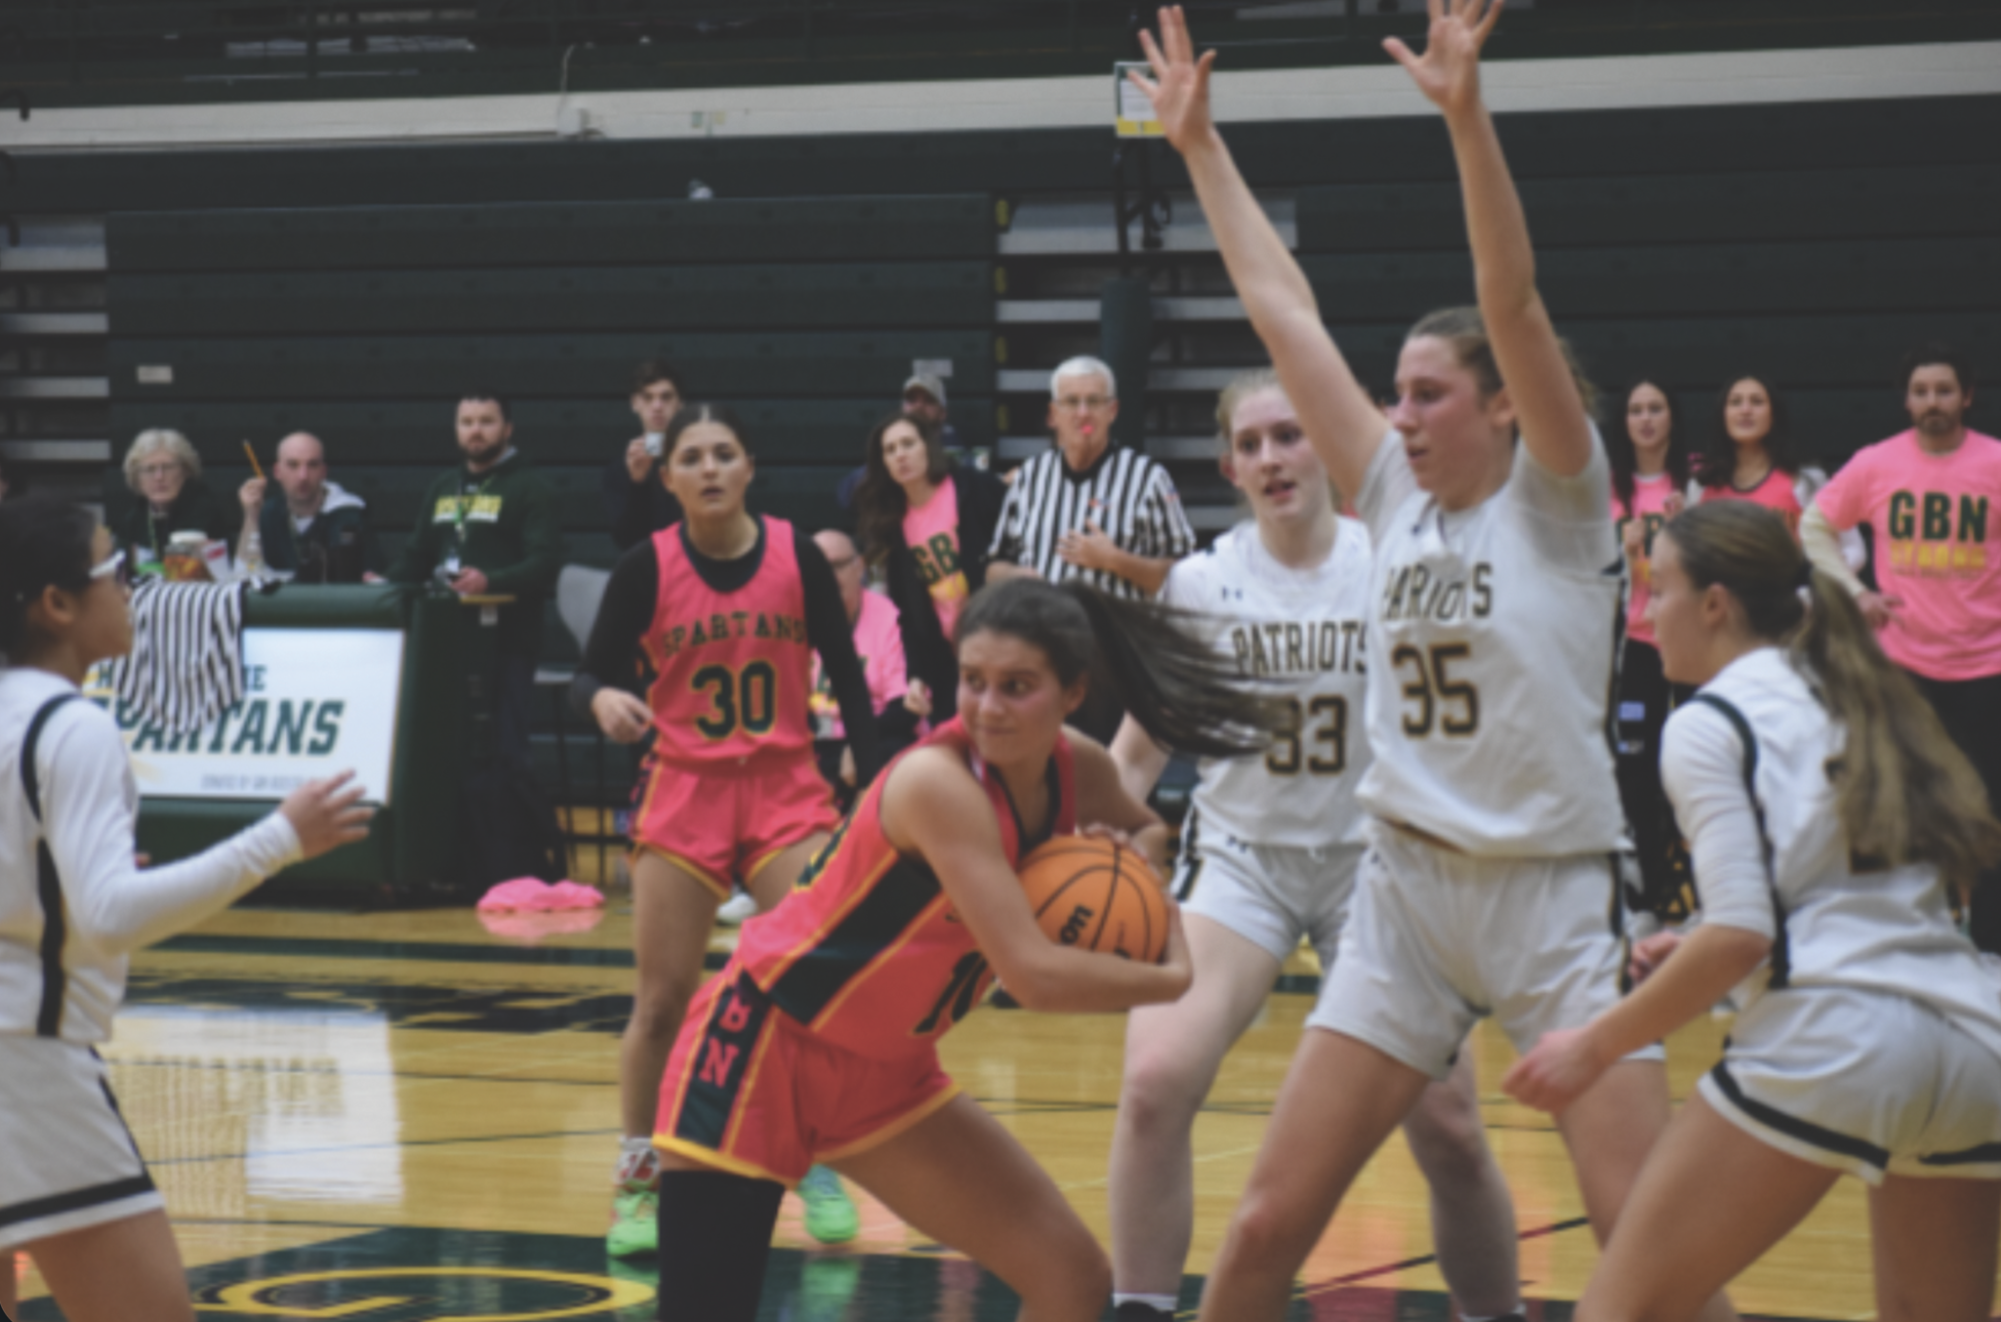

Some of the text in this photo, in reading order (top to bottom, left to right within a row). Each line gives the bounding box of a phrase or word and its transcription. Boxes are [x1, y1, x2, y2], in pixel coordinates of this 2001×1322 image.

[1888, 488, 1989, 544] GBN
[910, 532, 960, 583] GB
[689, 659, 777, 744] 30
[1391, 641, 1480, 738] 35
[88, 698, 345, 756] PATANS
[1265, 693, 1348, 777] 33
